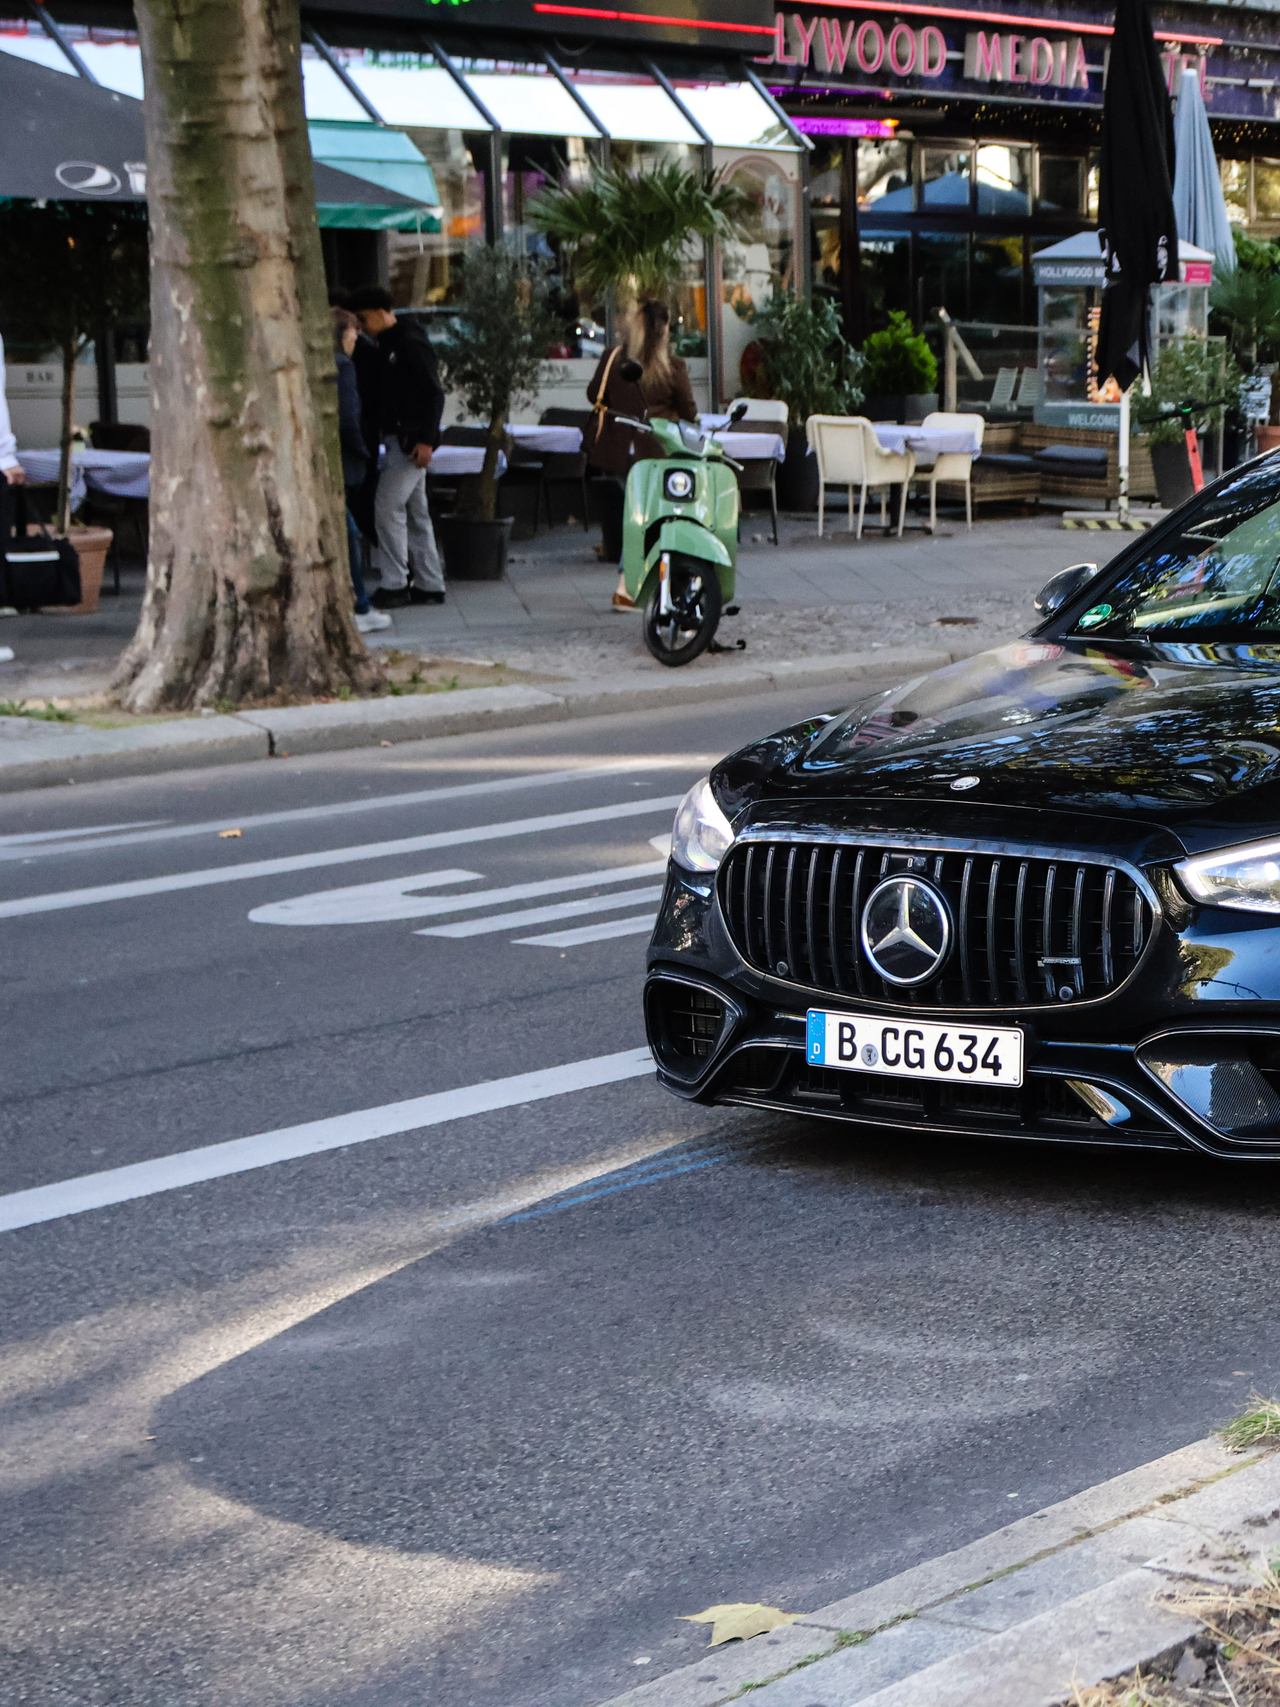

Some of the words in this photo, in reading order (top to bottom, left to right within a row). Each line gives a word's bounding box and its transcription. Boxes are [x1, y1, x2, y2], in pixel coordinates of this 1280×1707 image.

[754, 12, 947, 78] LYWOOD
[973, 31, 1089, 89] MEDIA
[1038, 267, 1093, 279] HOLLYWOOD
[1067, 413, 1120, 427] WELCOME
[813, 1042, 821, 1055] D
[838, 1021, 858, 1062] B
[881, 1027, 926, 1070] CG
[933, 1032, 1003, 1077] 634
